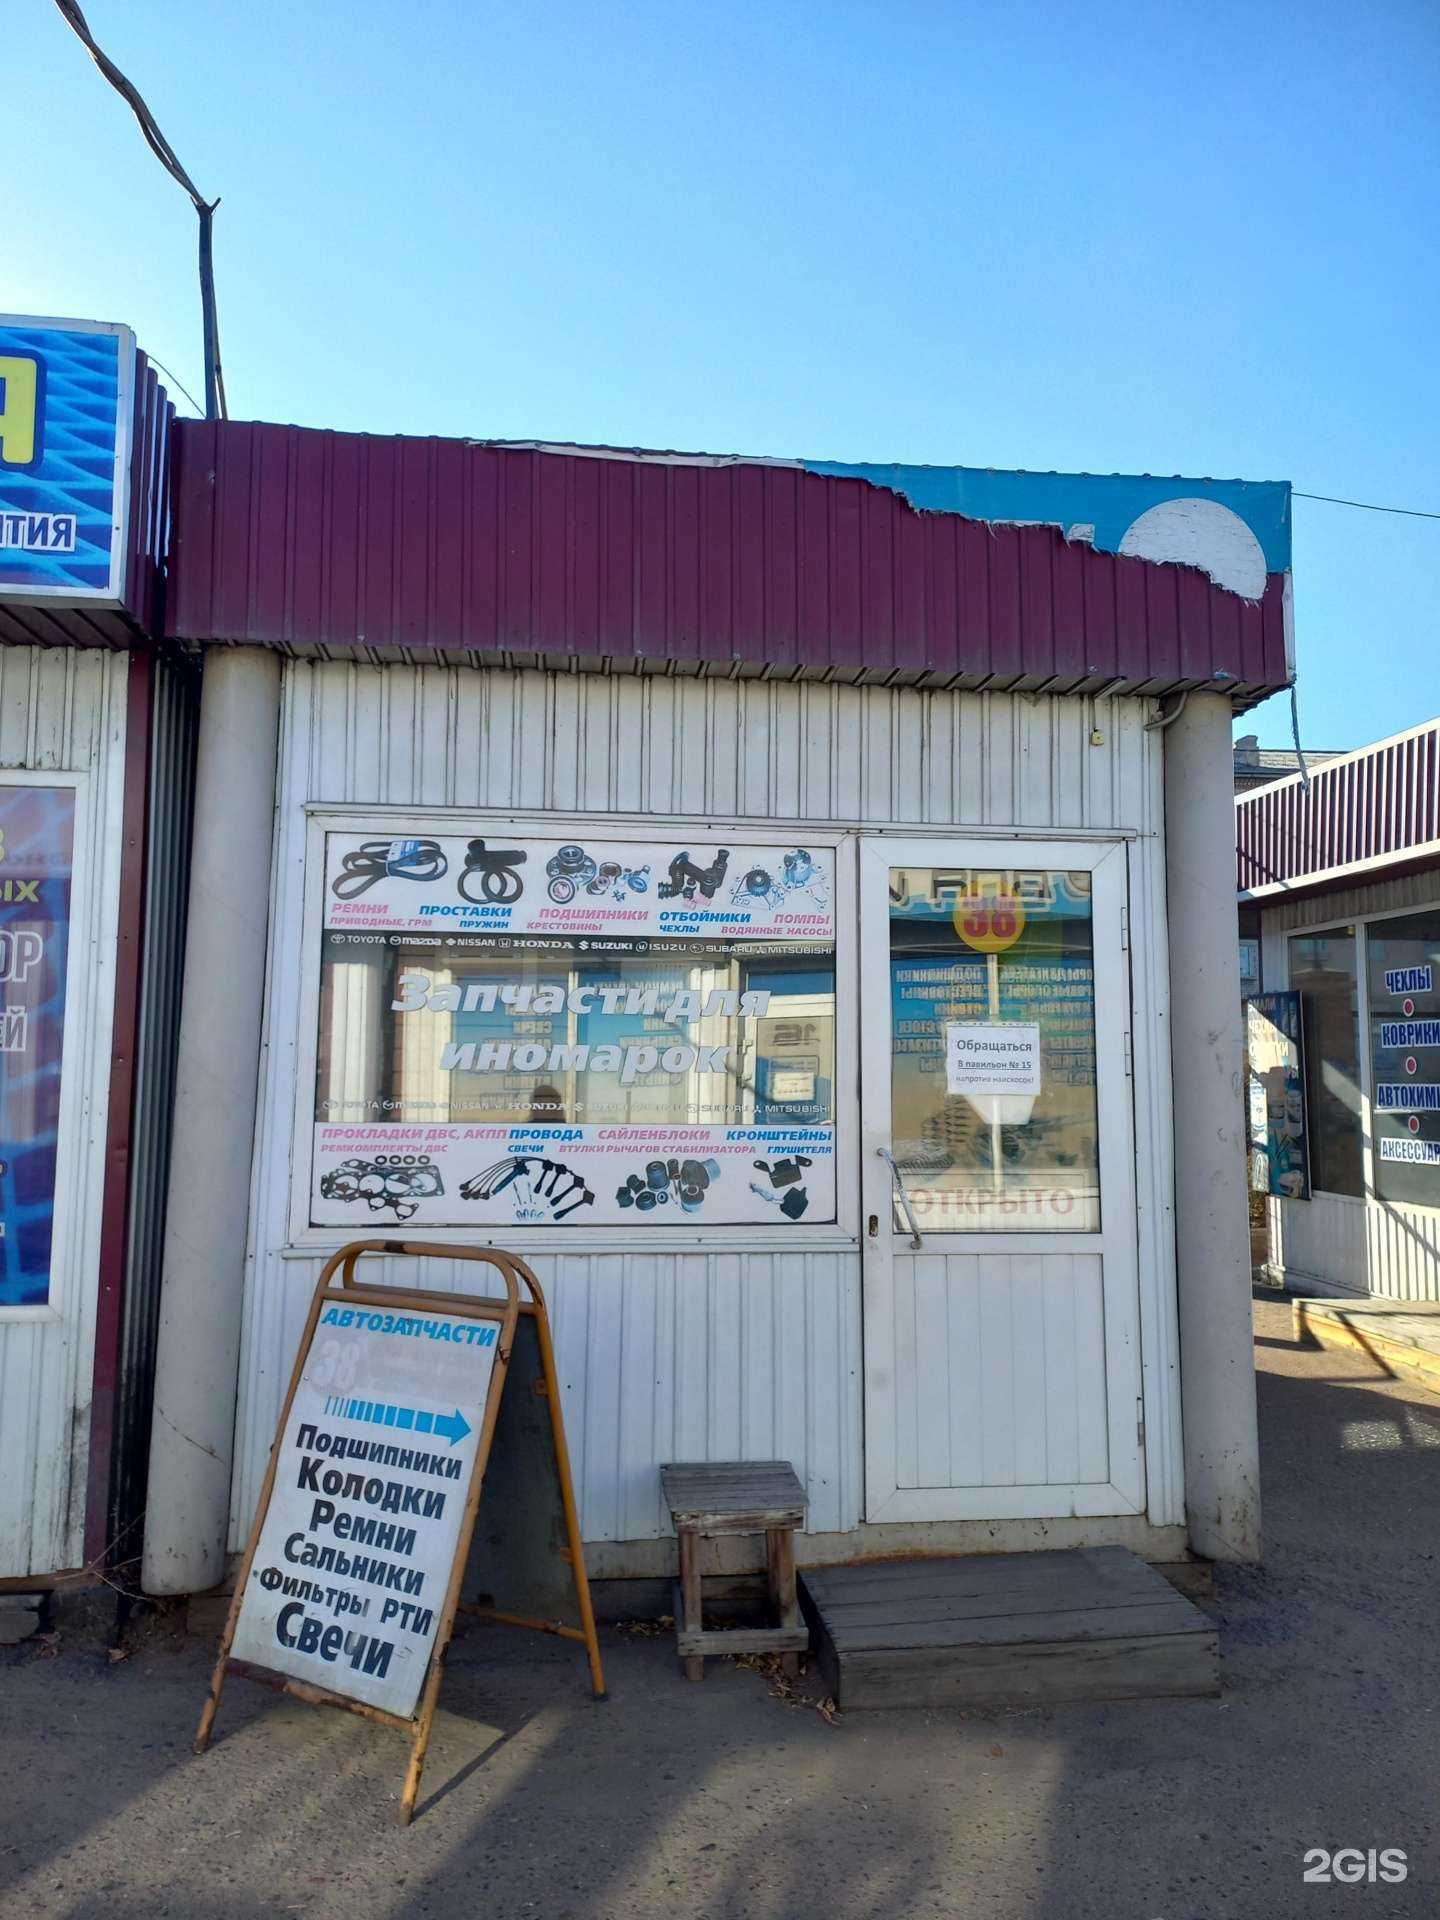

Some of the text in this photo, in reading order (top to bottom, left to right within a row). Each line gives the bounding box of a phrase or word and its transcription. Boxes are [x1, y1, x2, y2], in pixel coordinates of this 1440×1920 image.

[0, 515, 73, 548] ТИЯ
[331, 903, 389, 914] РЕМНИ
[418, 905, 513, 917] ПРОСТАВКИ
[539, 908, 649, 921] ПОДШИПНИКИ
[329, 917, 433, 927] ПРИВОДНЫЕ, ГРМ
[659, 910, 752, 924] ОТБОЙНИКИ
[773, 913, 830, 924] ПОМПЫ
[459, 919, 510, 929] ПРУЖИН
[527, 921, 604, 931] КРЕСТОВИНЫ
[659, 924, 700, 934] ЧЕХЛЫ
[721, 926, 833, 936] ВОДЯННЫЕ НАСОСЫ
[347, 936, 386, 944] TOYOTA
[457, 938, 496, 947] NISSAN
[512, 940, 575, 949] HONDA
[590, 942, 633, 950] SUZUKI
[649, 944, 687, 952] ISUZU
[705, 944, 753, 953] SUBARU
[767, 946, 832, 954] MITSUBISHI
[1385, 968, 1431, 994] ЧЕХЛЫ
[391, 974, 773, 1023] Запчасти для
[0, 1007, 26, 1049] Й
[1382, 1022, 1440, 1046] КОВРИКИ
[957, 1039, 1032, 1052] Обращаться
[440, 1041, 732, 1087] иномарок
[965, 1060, 1007, 1068] павильон
[1022, 1061, 1032, 1069] 15
[510, 1102, 566, 1111] HONDA
[765, 1105, 830, 1113] MITSUBISHI
[322, 1128, 508, 1140] ПРОКЛАДКИ ДВС, АКПП
[509, 1129, 584, 1142] ПРОВОДА
[598, 1127, 710, 1141] САЙЛЕНБЛОКИ
[726, 1128, 832, 1141] КРОНШТЕЙНЫ
[320, 1144, 449, 1153] РЕМКОМПЛЕКТЫ ДВС
[508, 1144, 544, 1153] СВЕЧИ
[558, 1144, 756, 1154] ВТУЛКИ РЫЧАГОВ СТАБИЛИЗАТОРА
[767, 1145, 832, 1154] ГЛУШИТЕЛЯ
[912, 1188, 1074, 1215] ОТКРЫТО
[321, 1307, 496, 1347] АВТОЗАПЧАСТИ
[296, 1423, 462, 1480] Подшипники
[297, 1456, 448, 1520] Колодки
[308, 1499, 417, 1556] Ремни
[284, 1532, 426, 1597] Сальники
[259, 1567, 371, 1618] Фильтры
[276, 1601, 396, 1679] Свечи
